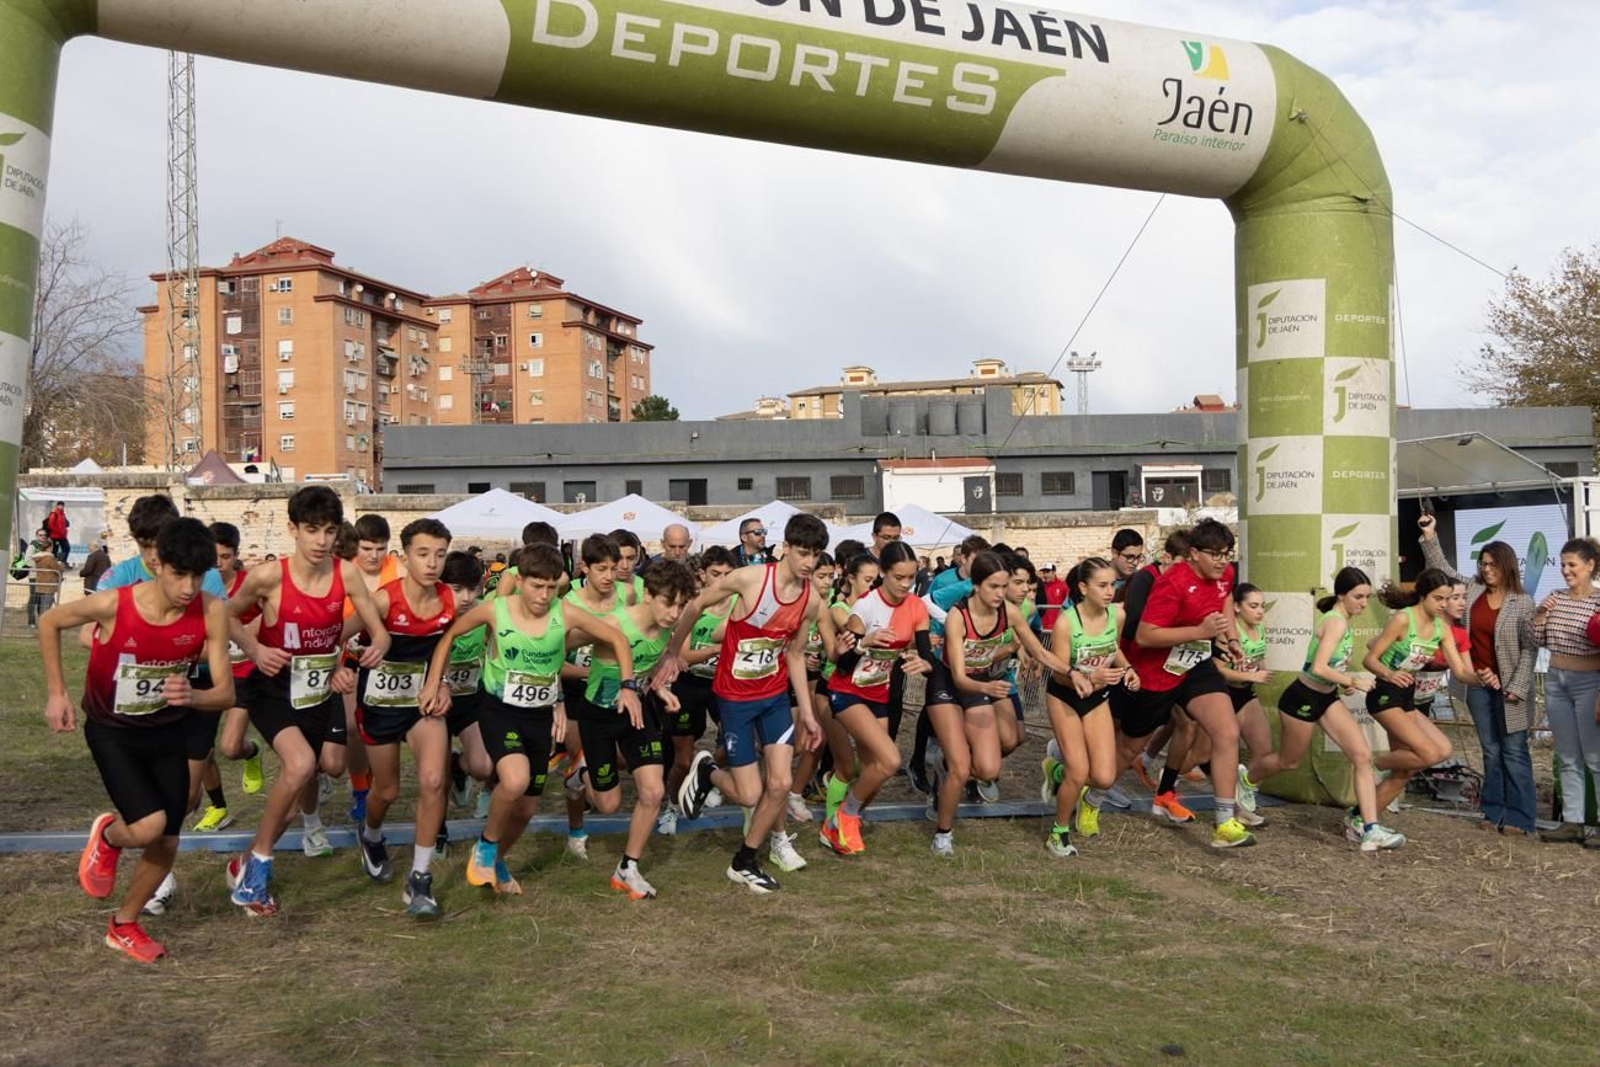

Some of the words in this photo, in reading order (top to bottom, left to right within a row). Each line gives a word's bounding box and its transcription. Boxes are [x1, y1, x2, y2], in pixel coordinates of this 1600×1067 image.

[865, 0, 946, 36] DE
[963, 3, 1110, 64] JAÉN
[532, 0, 1000, 115] DEPORTES
[1157, 78, 1253, 136] Jaén
[1334, 314, 1387, 325] DEPORTES
[1332, 470, 1386, 480] DEPORTES
[136, 679, 165, 696] 94
[307, 670, 333, 688] 87
[374, 673, 412, 691] 303
[511, 685, 551, 702] 496
